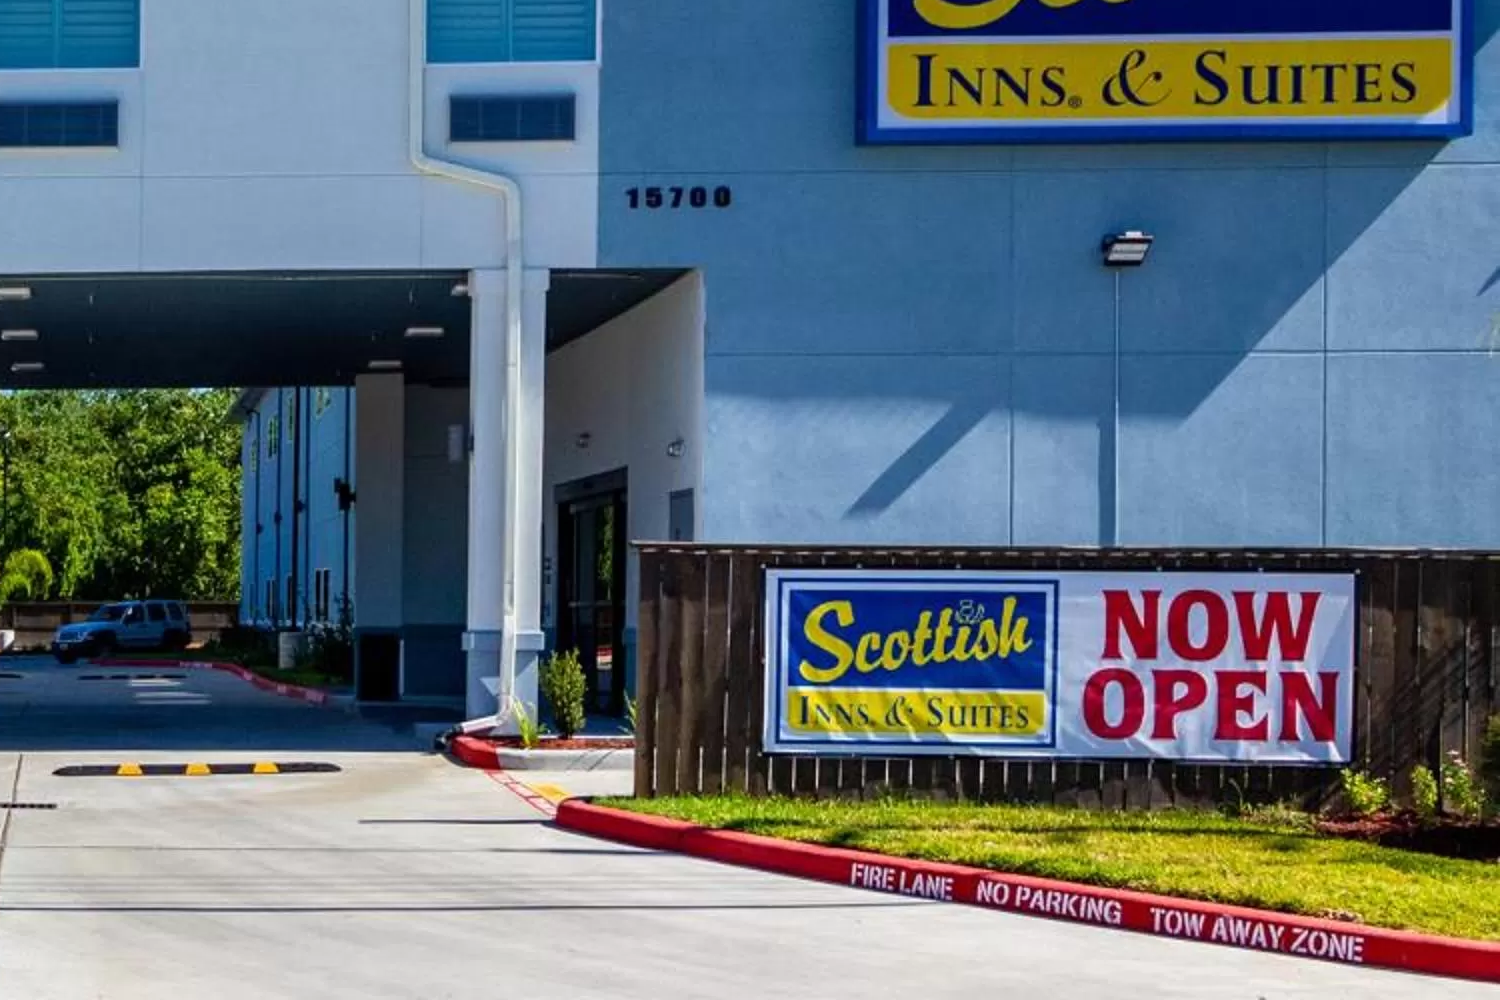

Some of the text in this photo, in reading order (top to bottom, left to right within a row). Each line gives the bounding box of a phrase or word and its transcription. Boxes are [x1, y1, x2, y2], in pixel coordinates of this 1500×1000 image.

[1102, 50, 1172, 107] &
[1194, 50, 1417, 105] SUITES
[625, 185, 731, 209] 15700
[800, 596, 1033, 683] Scottish
[1102, 589, 1322, 661] NOW
[884, 696, 914, 728] &
[927, 696, 1030, 729] SUITES
[1083, 669, 1340, 742] OPEN
[850, 862, 1364, 963] FIRE LANE NO PARKING TOW AWAY ZONE
